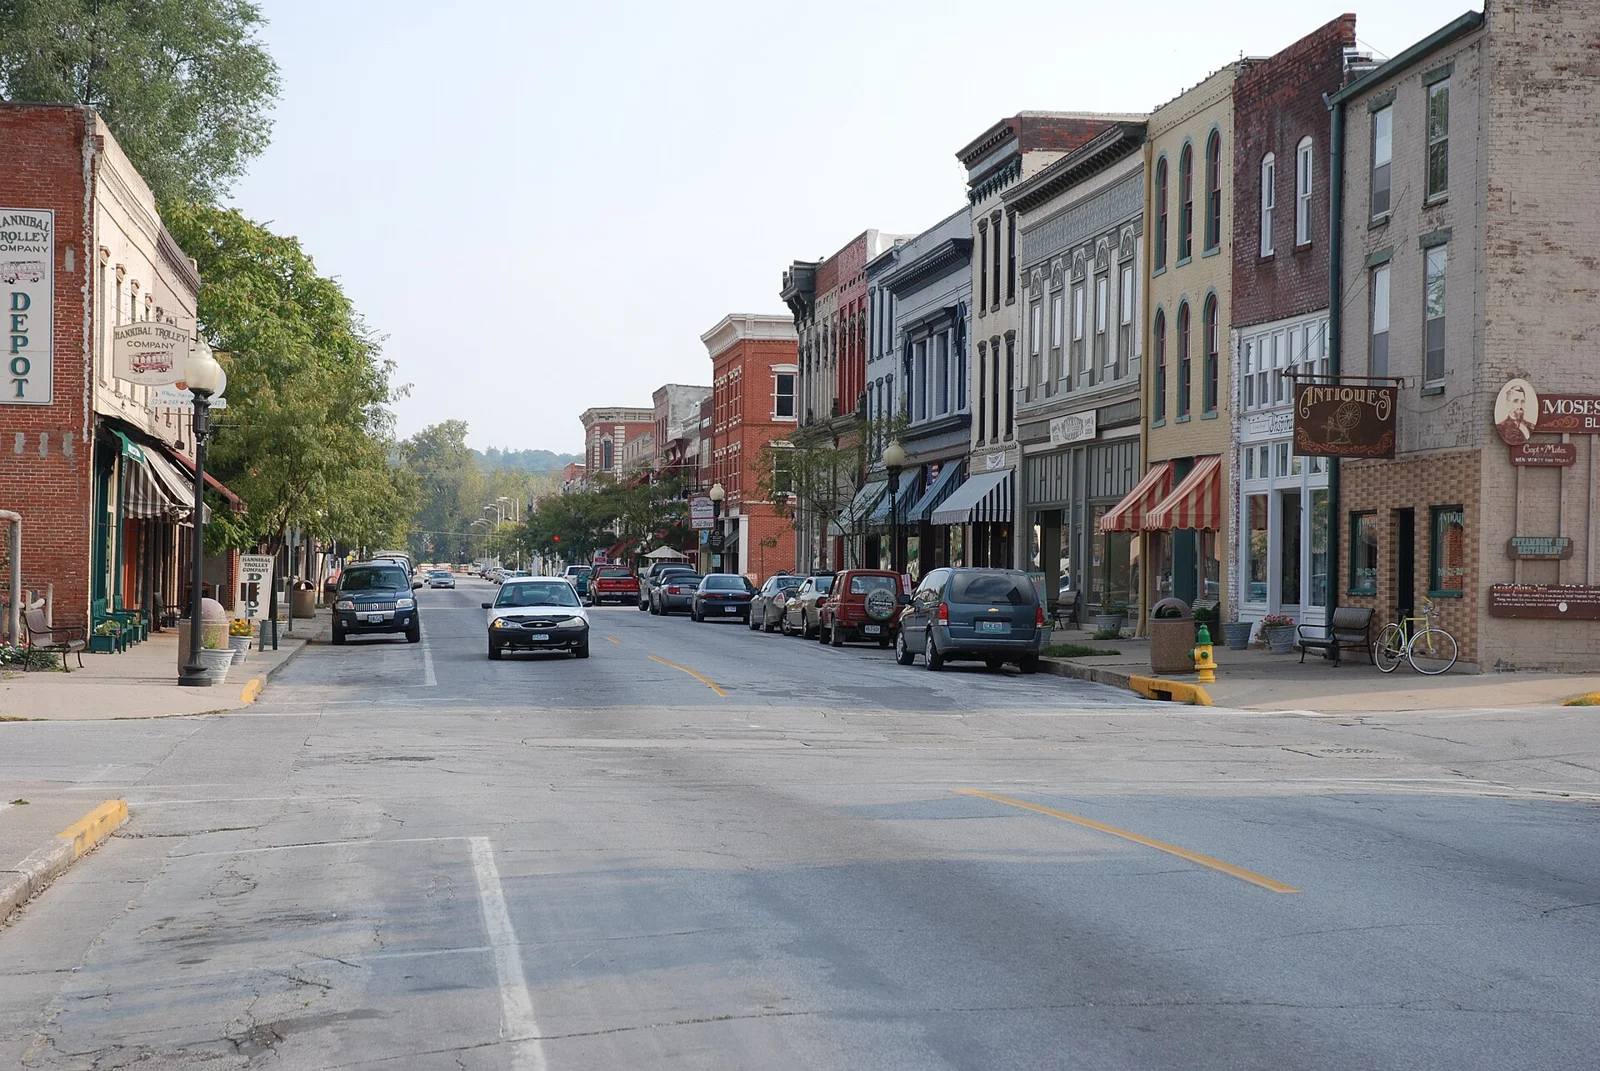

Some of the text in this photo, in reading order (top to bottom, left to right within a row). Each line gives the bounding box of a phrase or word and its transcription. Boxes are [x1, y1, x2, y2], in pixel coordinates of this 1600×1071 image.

[0, 215, 50, 232] ANNIBAL
[0, 231, 49, 244] ROLLEY
[0, 244, 49, 253] OMPANY
[115, 327, 187, 343] HANNIBAL TROLLEY
[10, 291, 31, 398] DEPOT
[127, 340, 175, 349] COMPANY
[1299, 386, 1391, 420] ANTIQUES
[1543, 399, 1600, 415] MOSES
